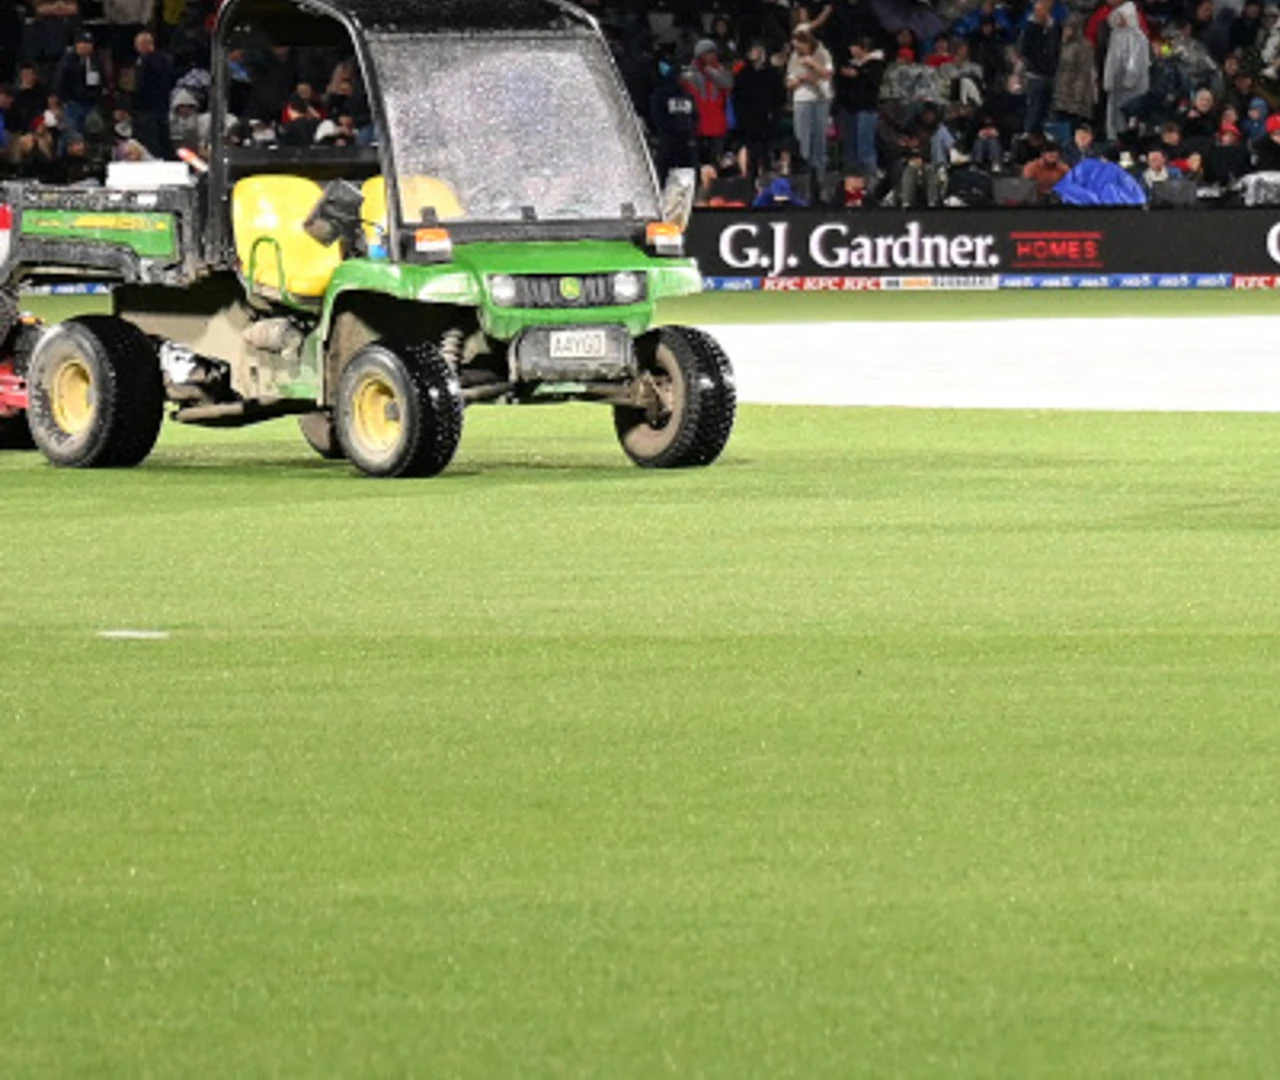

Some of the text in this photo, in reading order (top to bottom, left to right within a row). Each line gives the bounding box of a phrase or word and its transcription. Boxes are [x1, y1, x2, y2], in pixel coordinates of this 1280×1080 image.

[718, 221, 1098, 276] G.J. Gardner. HOMES
[763, 277, 802, 290] KFC
[803, 277, 841, 290] KFC
[842, 277, 880, 290] KFC
[1234, 275, 1273, 288] KFC
